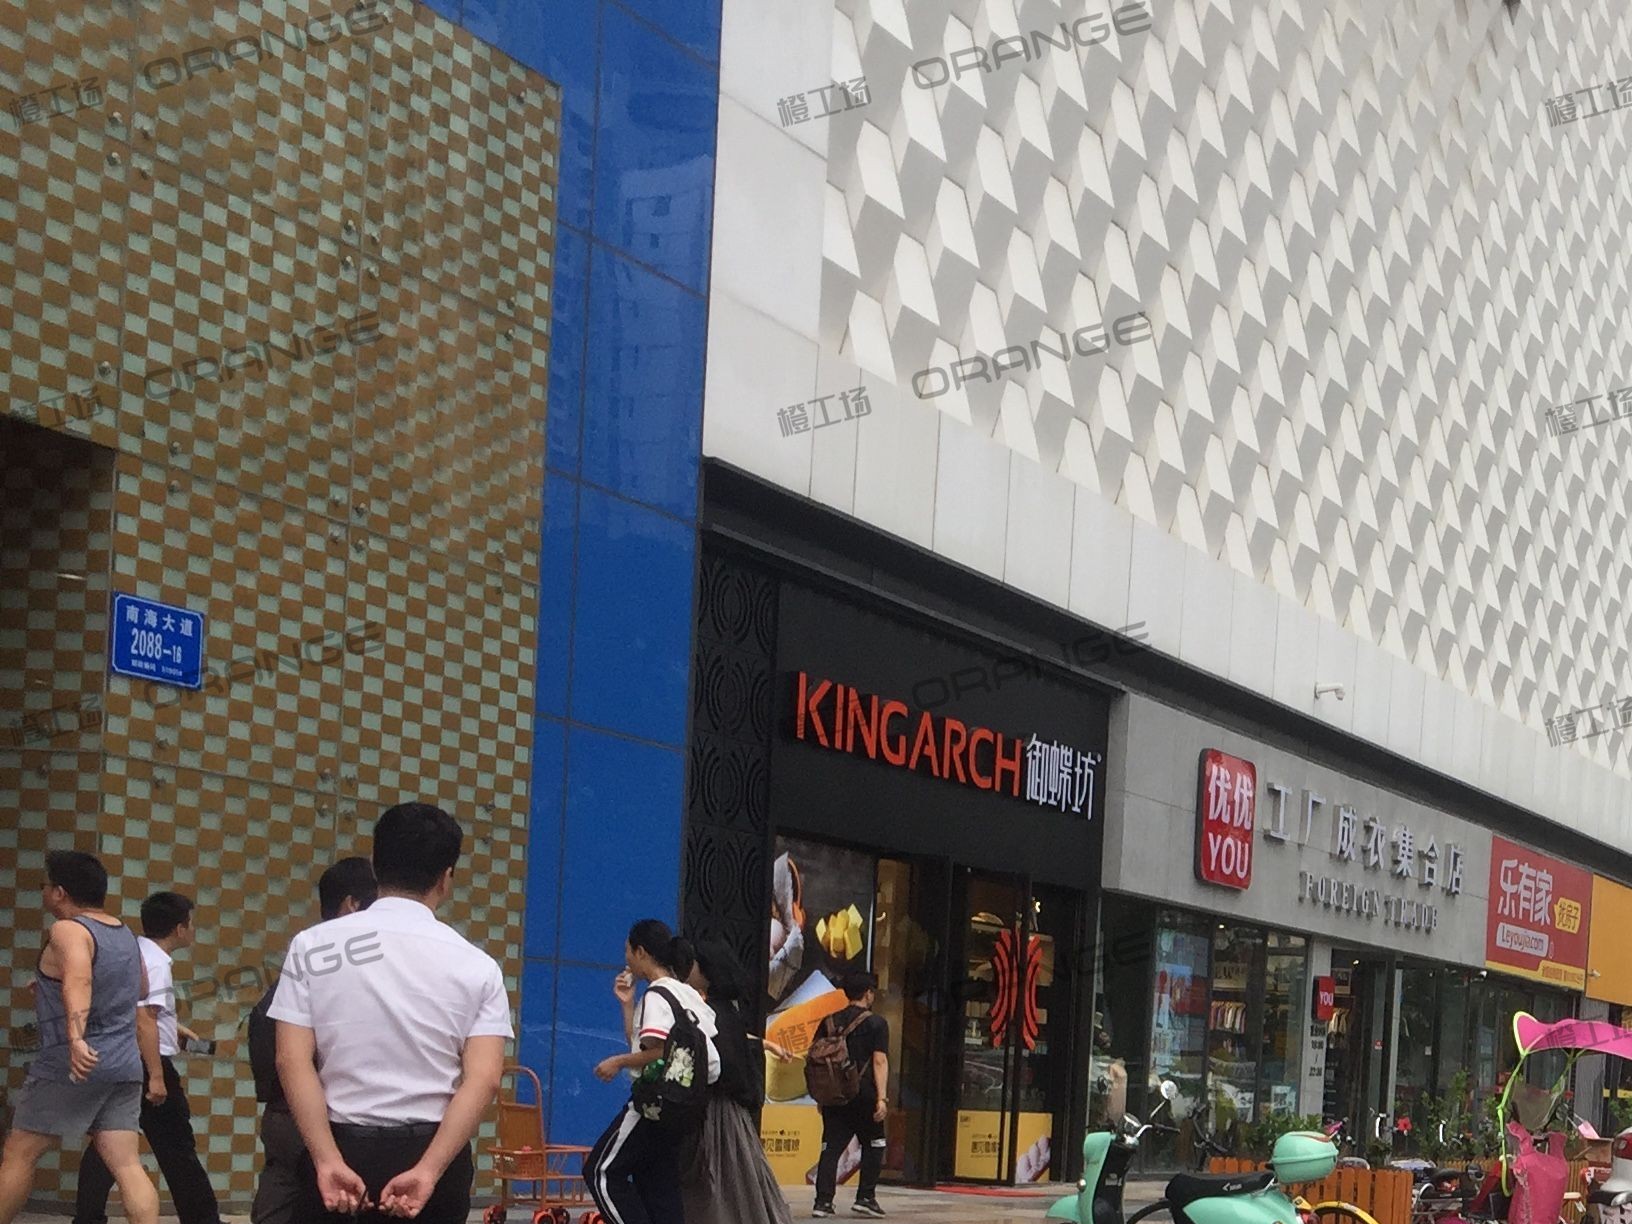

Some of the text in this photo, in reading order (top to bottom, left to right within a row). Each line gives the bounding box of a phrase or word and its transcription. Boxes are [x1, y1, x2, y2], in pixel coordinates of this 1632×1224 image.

[126, 605, 193, 637] 南海大道
[795, 671, 1022, 797] KINGARCH
[1026, 733, 1096, 821] 御蝶坊
[1208, 764, 1253, 831] 优优
[1208, 833, 1249, 880] YOU
[1267, 783, 1464, 895] 工厂成衣集合店
[1302, 872, 1438, 930] FOREIGN TRADE
[1497, 858, 1553, 926] 乐有家
[1319, 991, 1334, 1006] YOU
